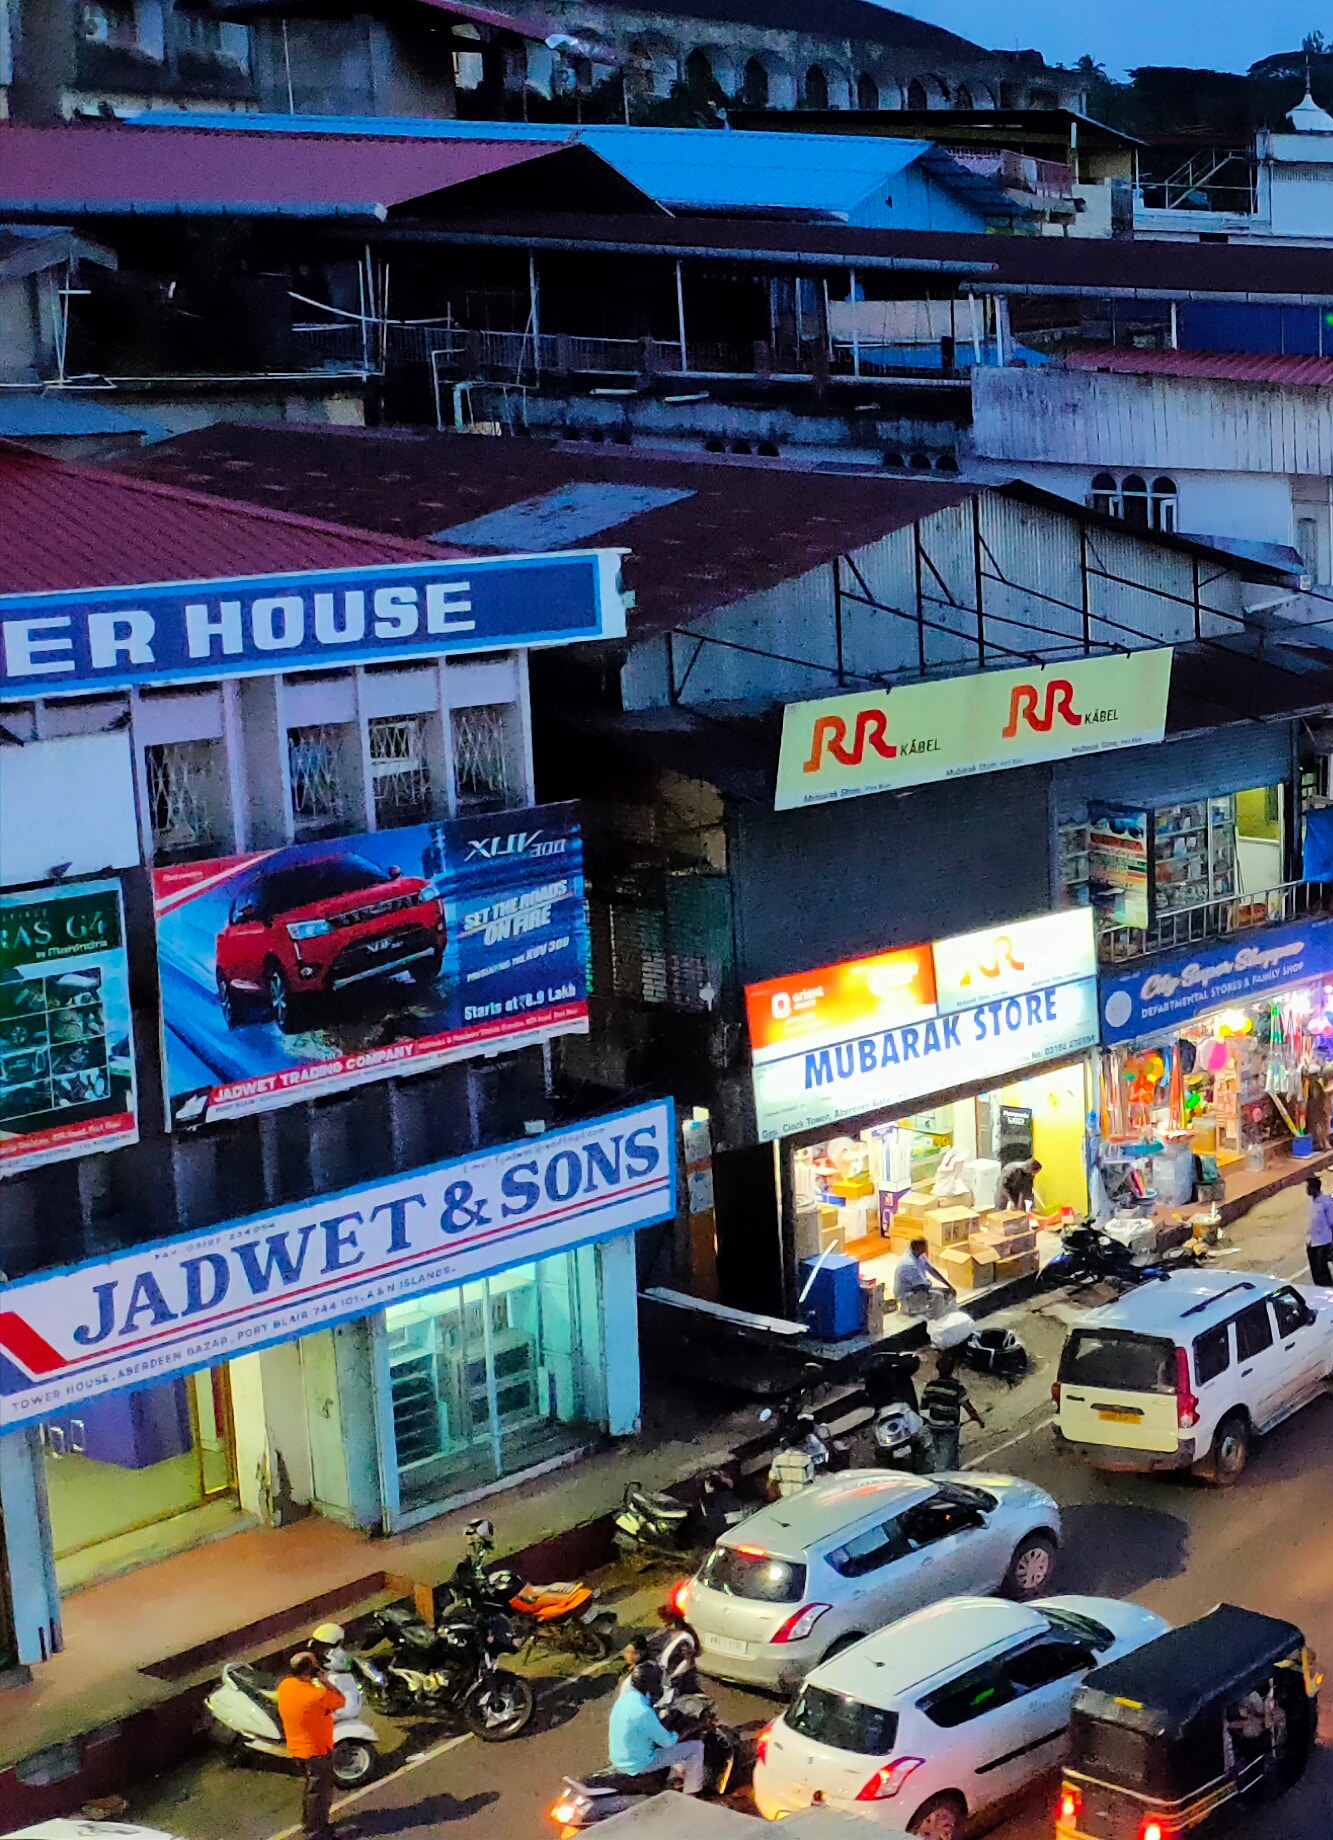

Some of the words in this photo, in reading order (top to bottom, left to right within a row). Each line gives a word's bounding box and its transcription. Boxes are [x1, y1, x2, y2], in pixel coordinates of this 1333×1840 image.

[185, 581, 476, 660] HOUSE
[1002, 679, 1082, 739] RR
[803, 708, 897, 773] RR
[66, 911, 105, 939] G4
[463, 907, 491, 932] SET
[520, 879, 568, 911] ROADS
[483, 917, 511, 946] ON
[512, 904, 552, 936] FIRE
[464, 1001, 502, 1021] Starts
[504, 996, 519, 1012] at
[547, 980, 577, 1002] Lakh
[1141, 991, 1209, 1019] DEPARTMENTAL
[1282, 961, 1304, 977] SHOP
[804, 1013, 961, 1090] MUBARAK
[973, 987, 1057, 1041] STORE
[214, 1079, 277, 1102] JADWET
[280, 1061, 344, 1088] TRADING
[345, 1043, 415, 1071] COMPANY
[72, 1192, 427, 1347] JADWET
[440, 1180, 492, 1235] &
[499, 1124, 661, 1218] SONS
[11, 1389, 61, 1412] TOWER
[117, 1352, 182, 1379] ABERDEEN
[237, 1324, 268, 1341] PORT
[272, 1311, 309, 1329] BLAIR
[314, 1303, 337, 1316] 744
[367, 1290, 376, 1299] A
[387, 1283, 396, 1293] N
